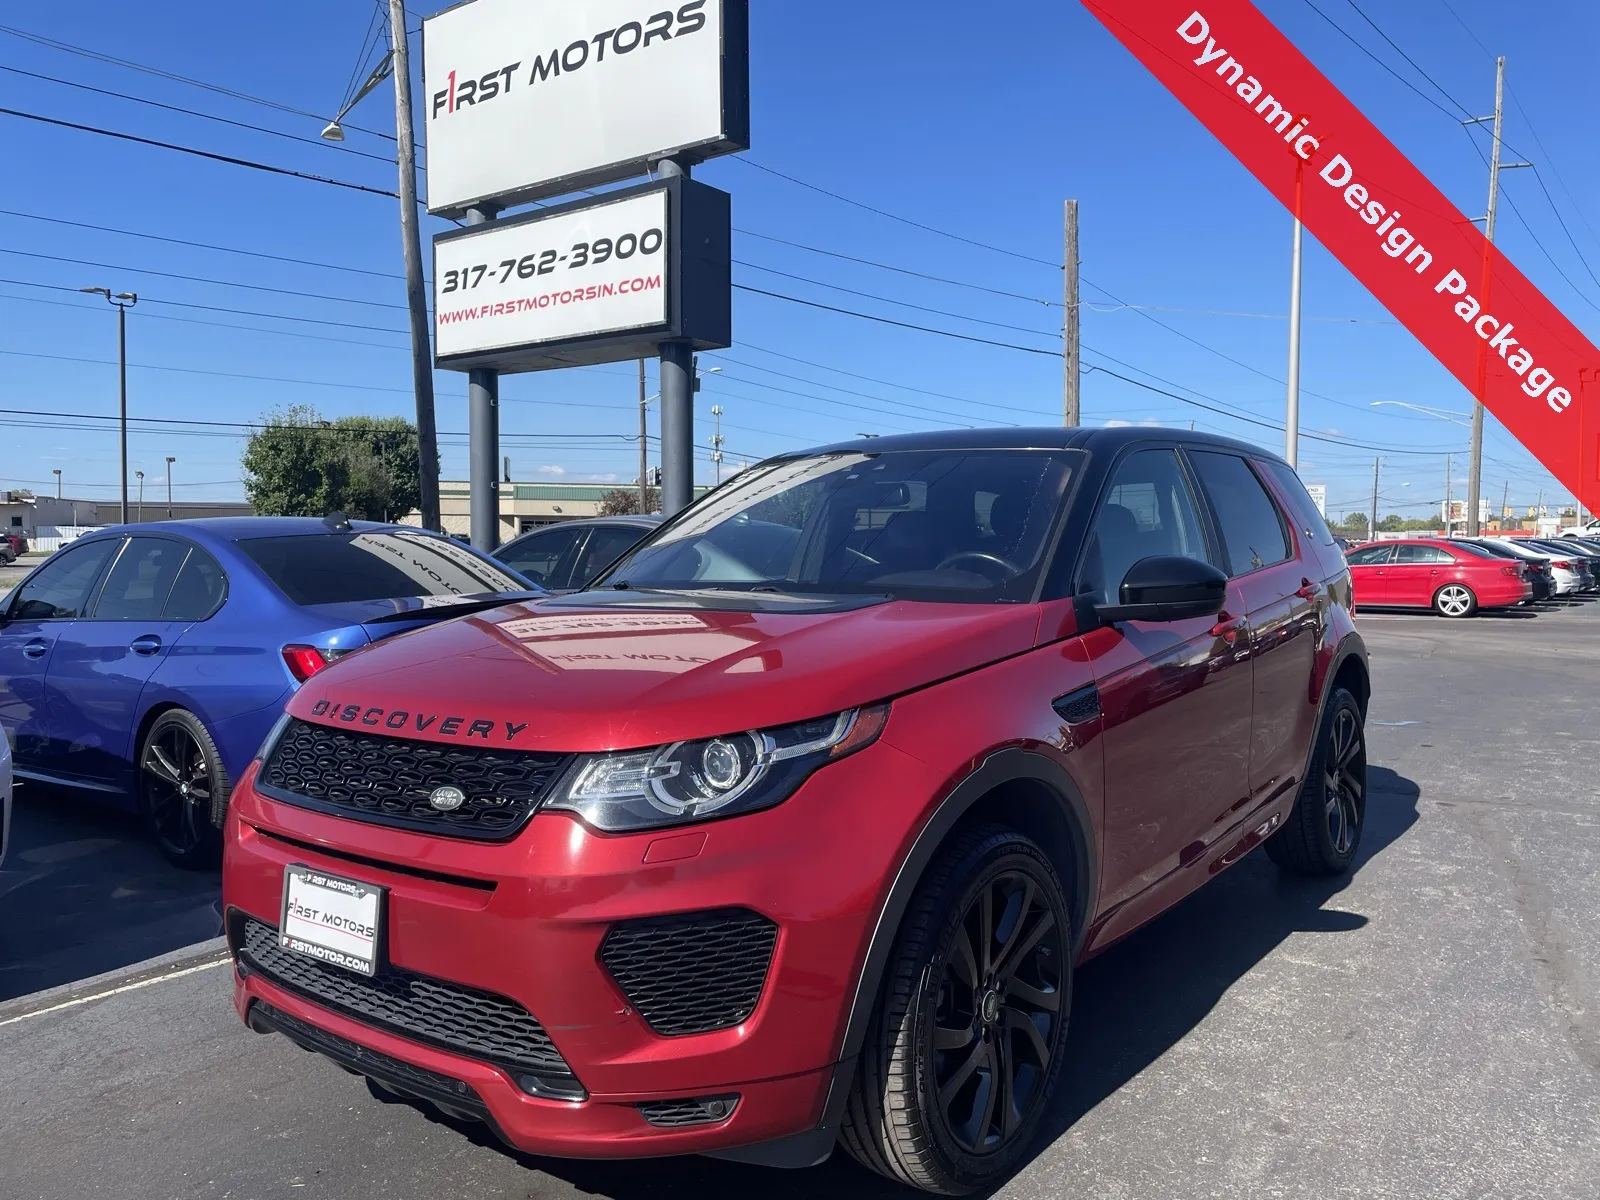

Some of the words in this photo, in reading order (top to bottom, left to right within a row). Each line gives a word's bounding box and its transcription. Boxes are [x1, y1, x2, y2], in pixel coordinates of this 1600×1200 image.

[528, 0, 708, 86] MOTORS
[441, 227, 663, 294] 317-762-3900
[438, 274, 662, 325] WWW.FIRSTMOTORSIN.COM
[311, 699, 530, 741] DISCOVERY
[326, 879, 357, 893] MOTORS
[321, 912, 374, 938] MOTORS
